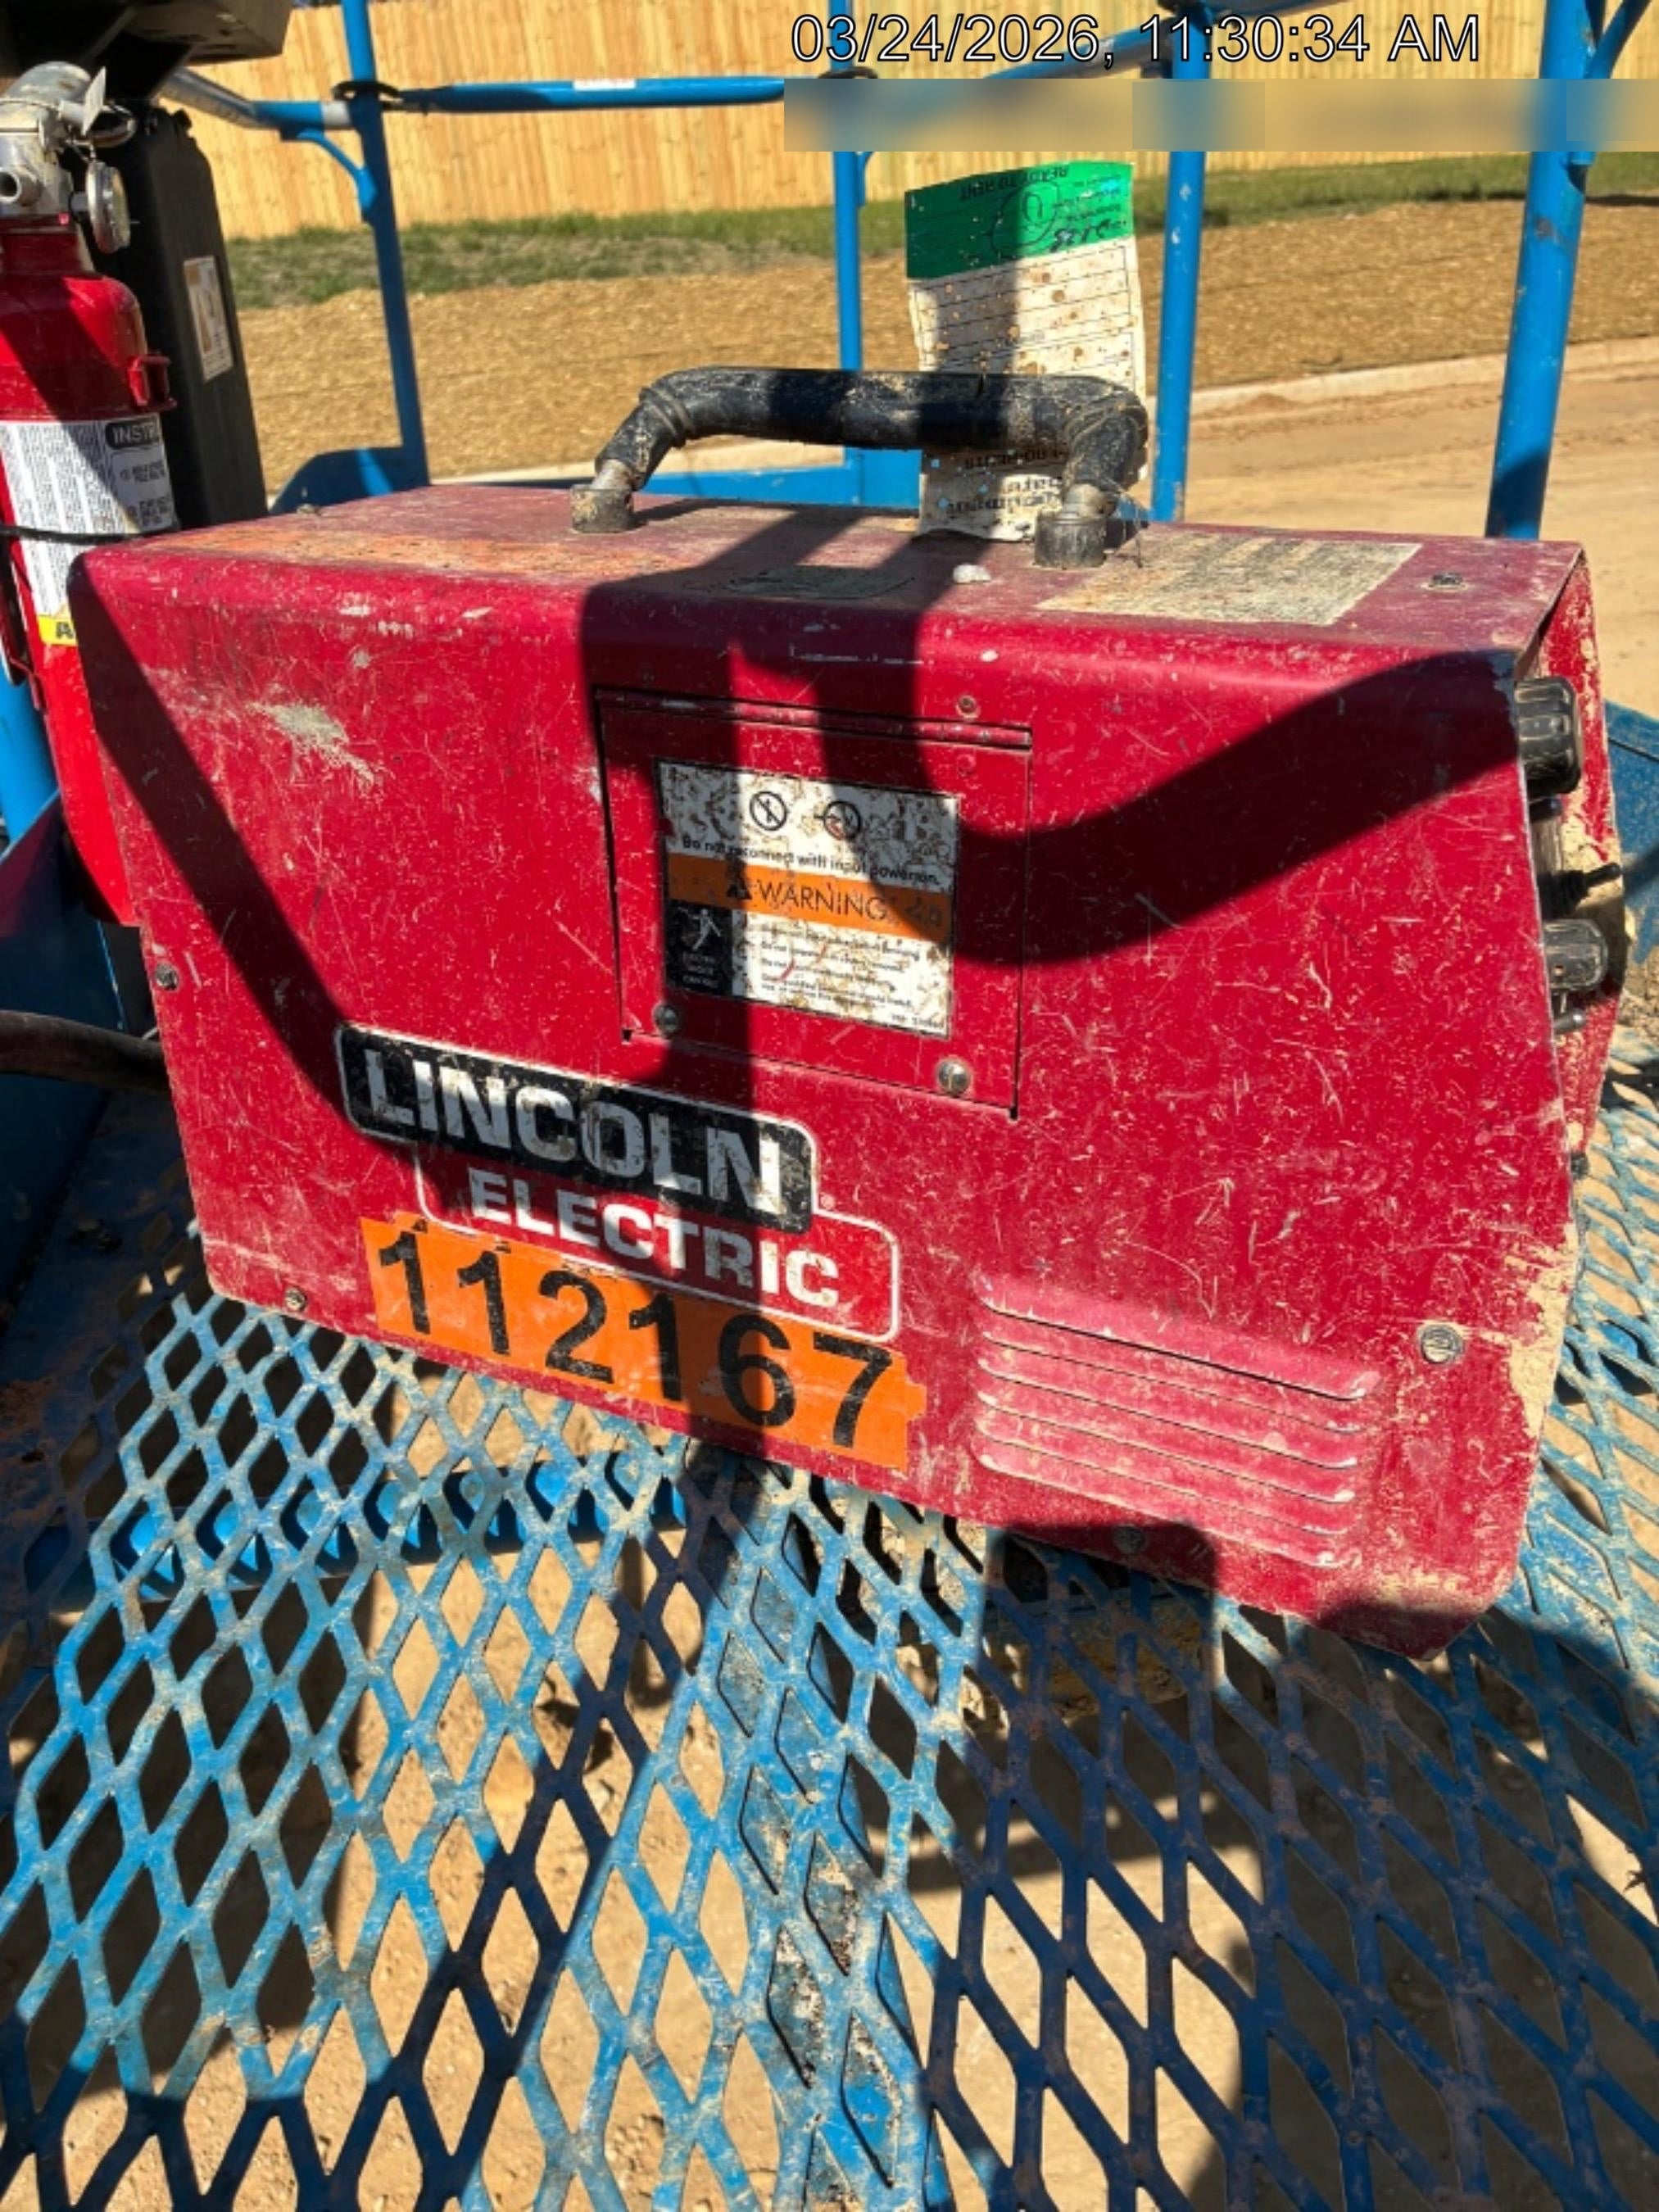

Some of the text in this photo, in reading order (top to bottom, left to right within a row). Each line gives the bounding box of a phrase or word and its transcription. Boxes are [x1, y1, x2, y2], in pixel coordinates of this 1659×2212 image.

[757, 879, 887, 922] WARNING
[798, 851, 827, 869] with
[364, 1049, 786, 1216] LINCOLN
[468, 1169, 840, 1308] ELECTRIC
[379, 1229, 893, 1448] 112167
